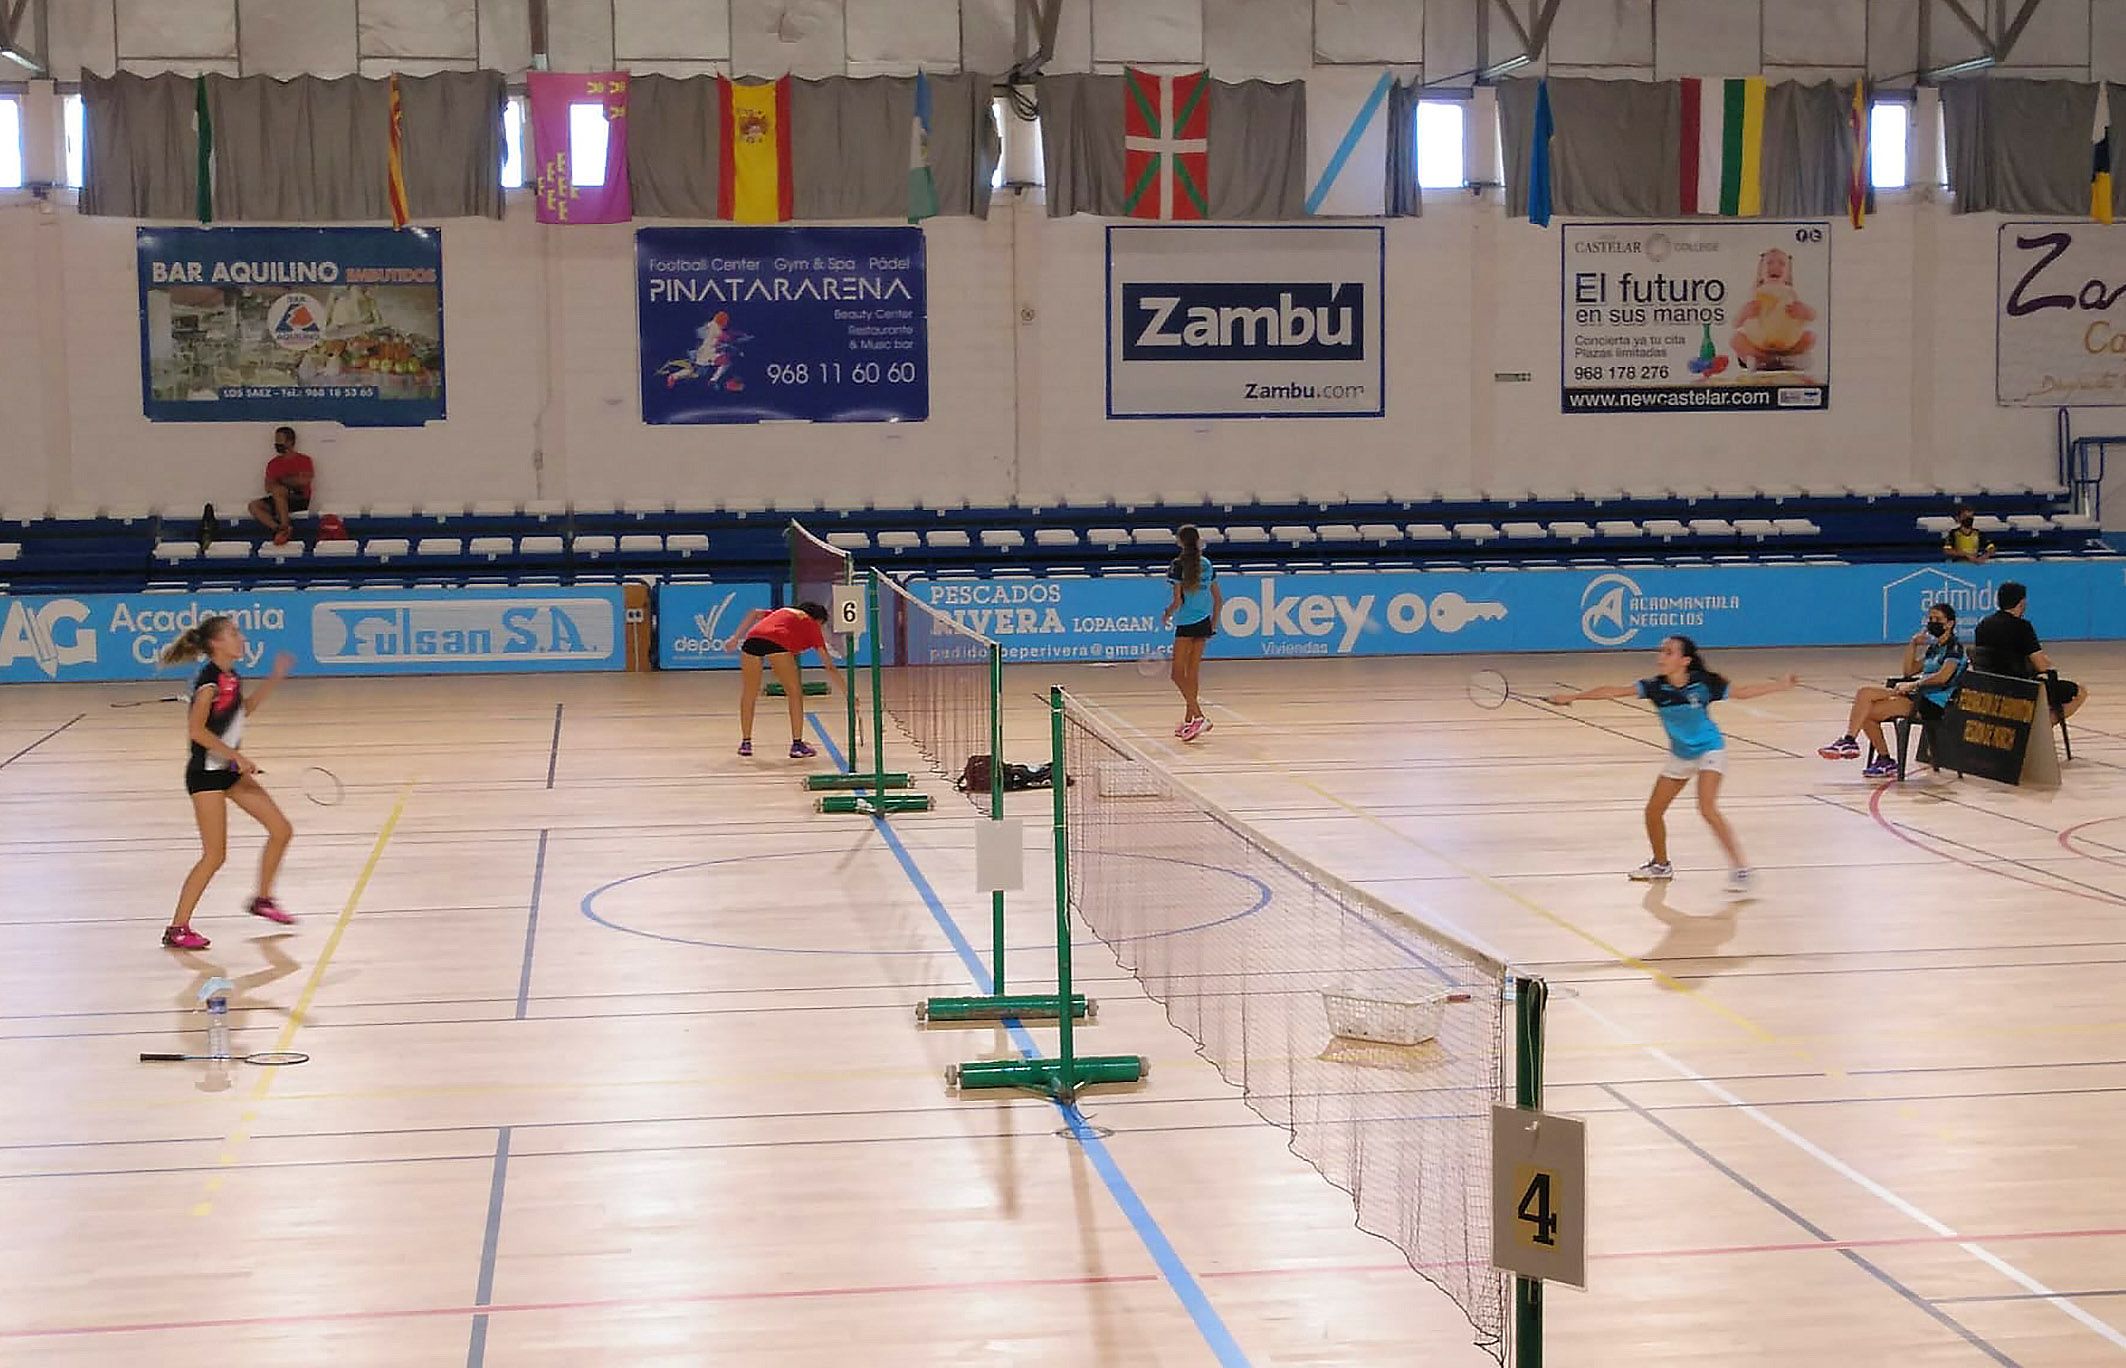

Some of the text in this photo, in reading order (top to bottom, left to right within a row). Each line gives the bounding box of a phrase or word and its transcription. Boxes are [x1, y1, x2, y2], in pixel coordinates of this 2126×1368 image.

[1575, 241, 1642, 254] CASTELAR
[152, 261, 203, 283] BAR
[211, 260, 339, 284] AQUILINO
[711, 258, 760, 272] Center
[774, 257, 809, 272] Gym
[813, 258, 825, 270] &
[828, 257, 856, 272] Spa
[869, 256, 911, 270] Pádel
[1575, 272, 1725, 304] El futuro
[834, 309, 914, 321] Beauty Center
[1135, 282, 1354, 347] Zambú
[1576, 306, 1725, 323] en sus manos
[861, 340, 892, 349] Music
[894, 340, 914, 349] bar
[1575, 335, 1686, 347] Concierta ya tu cita
[1575, 347, 1668, 358] Plazas limitadas
[767, 361, 916, 385] 968 11 60 60
[1574, 365, 1669, 380] 968 178 276
[1244, 381, 1365, 400] Zambu.com
[1570, 389, 1770, 407] www.newcastelar.com
[930, 583, 1061, 605] PESCADOS
[109, 602, 285, 633] Academia
[843, 602, 857, 622] 6
[1220, 577, 1375, 653] okey
[1630, 612, 1704, 628] NEGOCIOS
[330, 604, 598, 656] Fulsan S.A.
[930, 608, 1066, 636] RIVERA
[1262, 641, 1328, 655] Viviendas
[1517, 1172, 1557, 1246] 4
